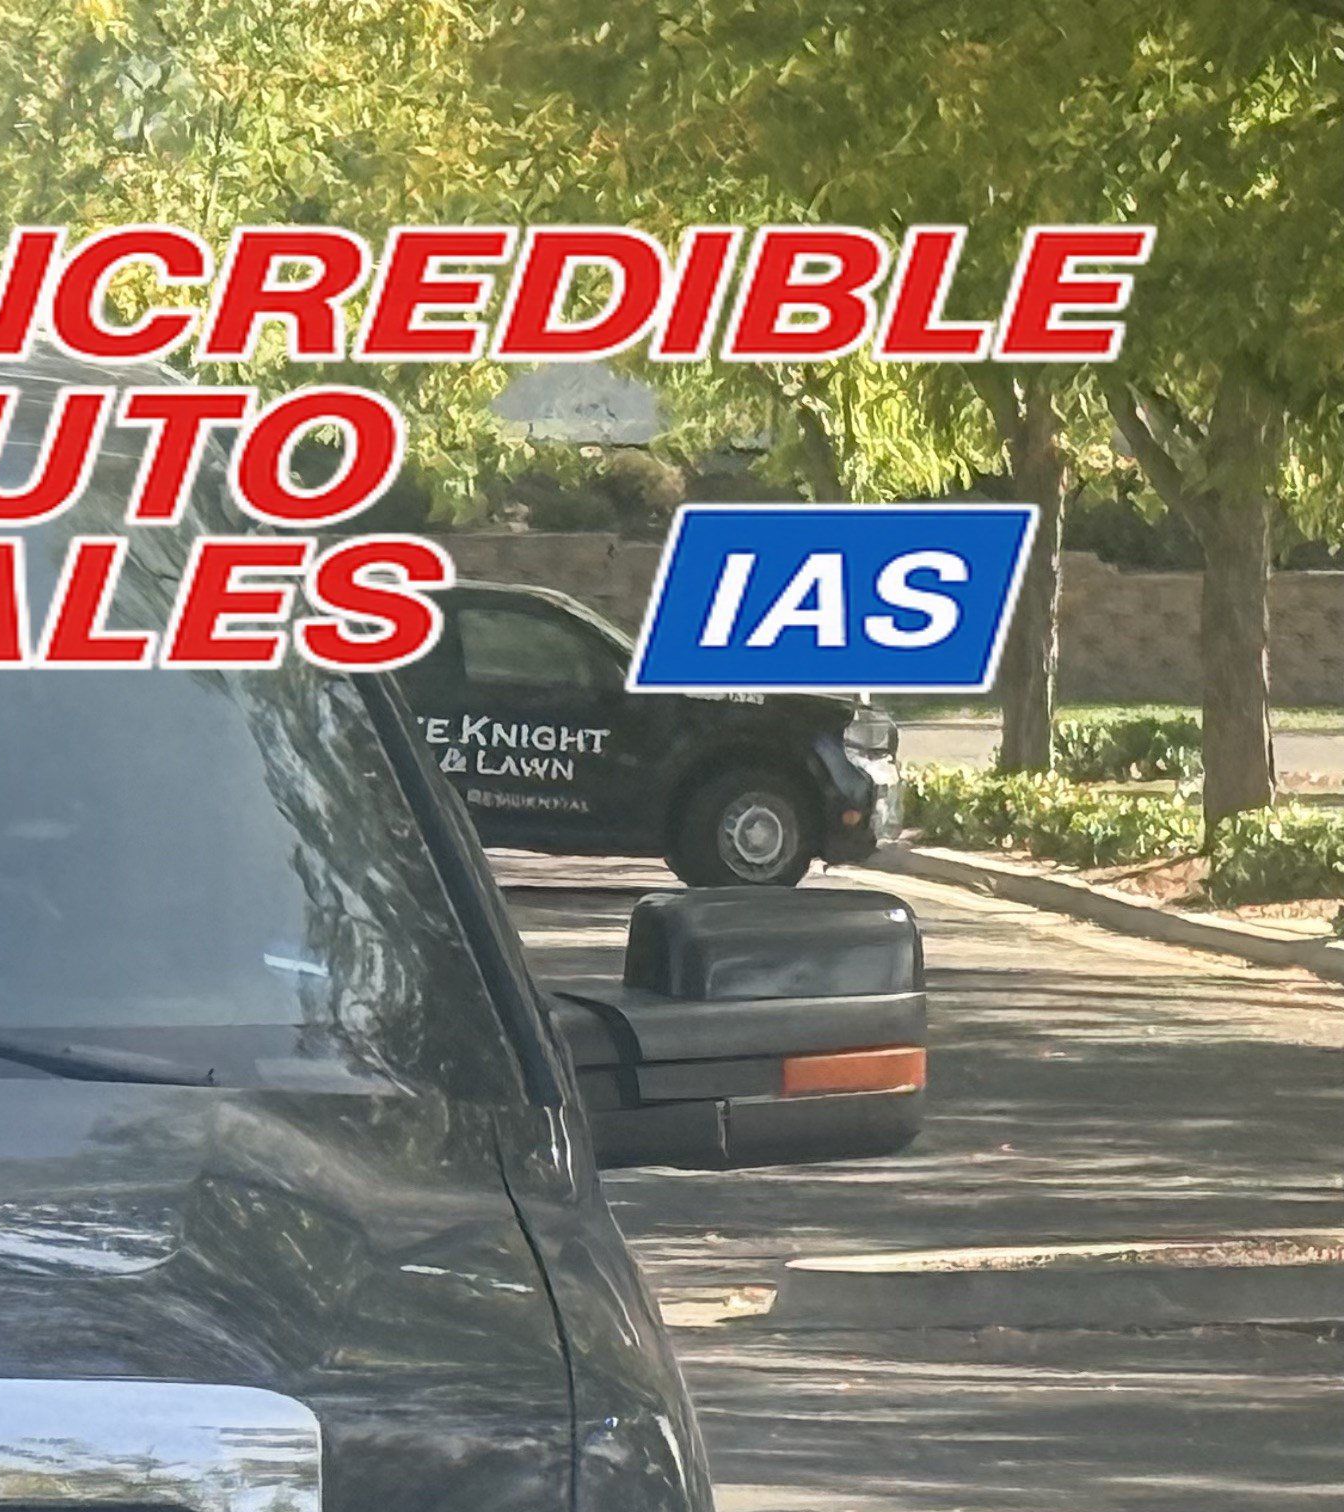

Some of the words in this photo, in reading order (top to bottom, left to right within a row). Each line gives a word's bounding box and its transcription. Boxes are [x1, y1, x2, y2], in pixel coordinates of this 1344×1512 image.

[416, 716, 450, 744] E
[458, 714, 611, 754] KNIGHT
[477, 749, 574, 781] LAWN
